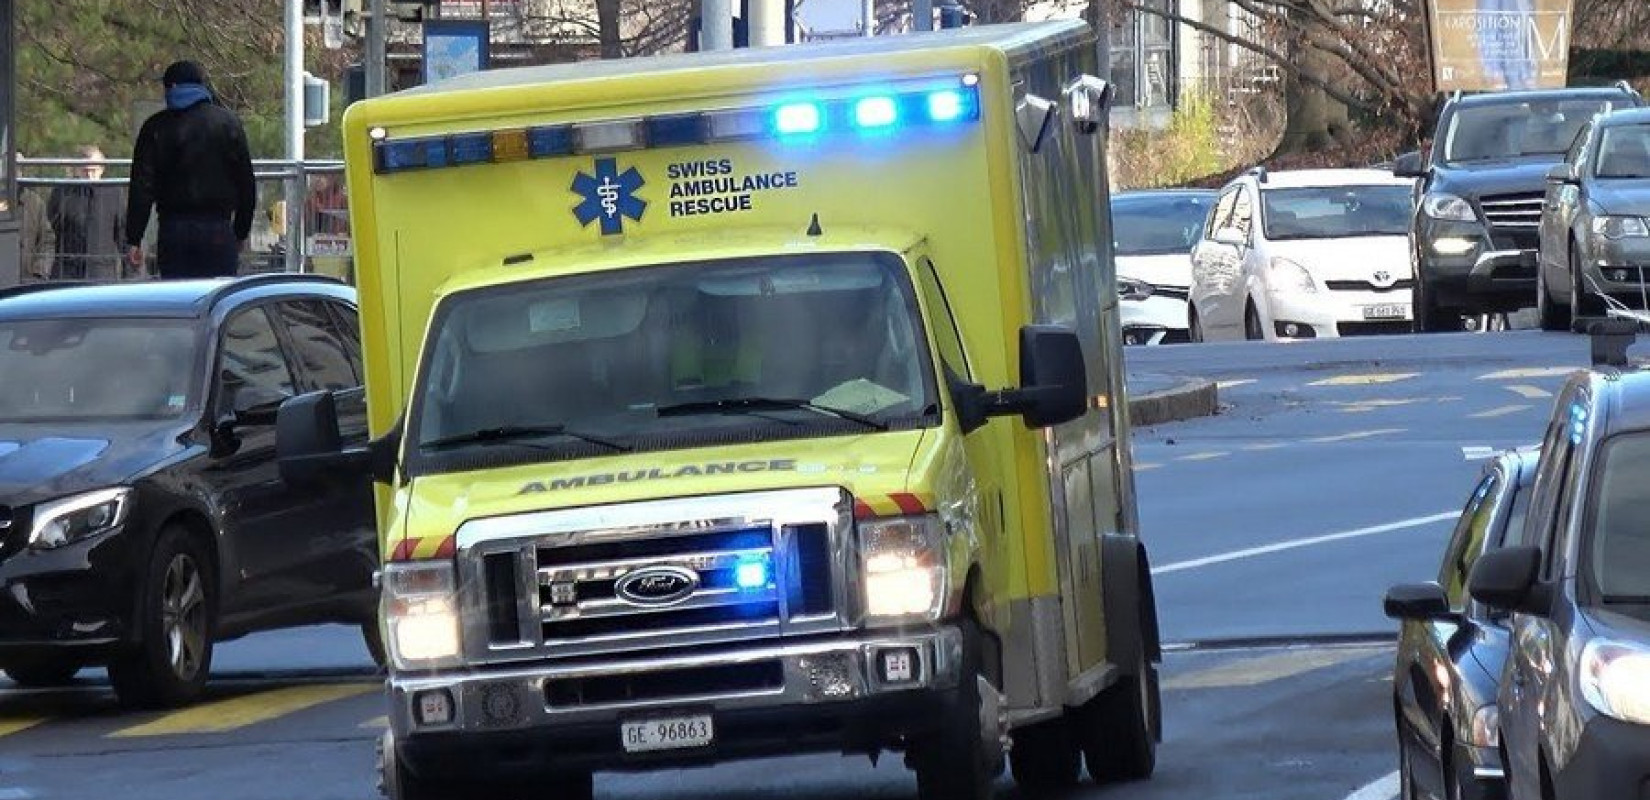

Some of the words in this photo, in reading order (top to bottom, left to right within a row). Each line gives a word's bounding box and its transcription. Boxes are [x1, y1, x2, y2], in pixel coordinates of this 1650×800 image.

[1528, 15, 1565, 60] M
[668, 159, 731, 179] SWISS
[670, 171, 797, 198] AMBULANCE
[670, 194, 752, 217] RESCUE
[518, 460, 795, 494] AMBULANCE
